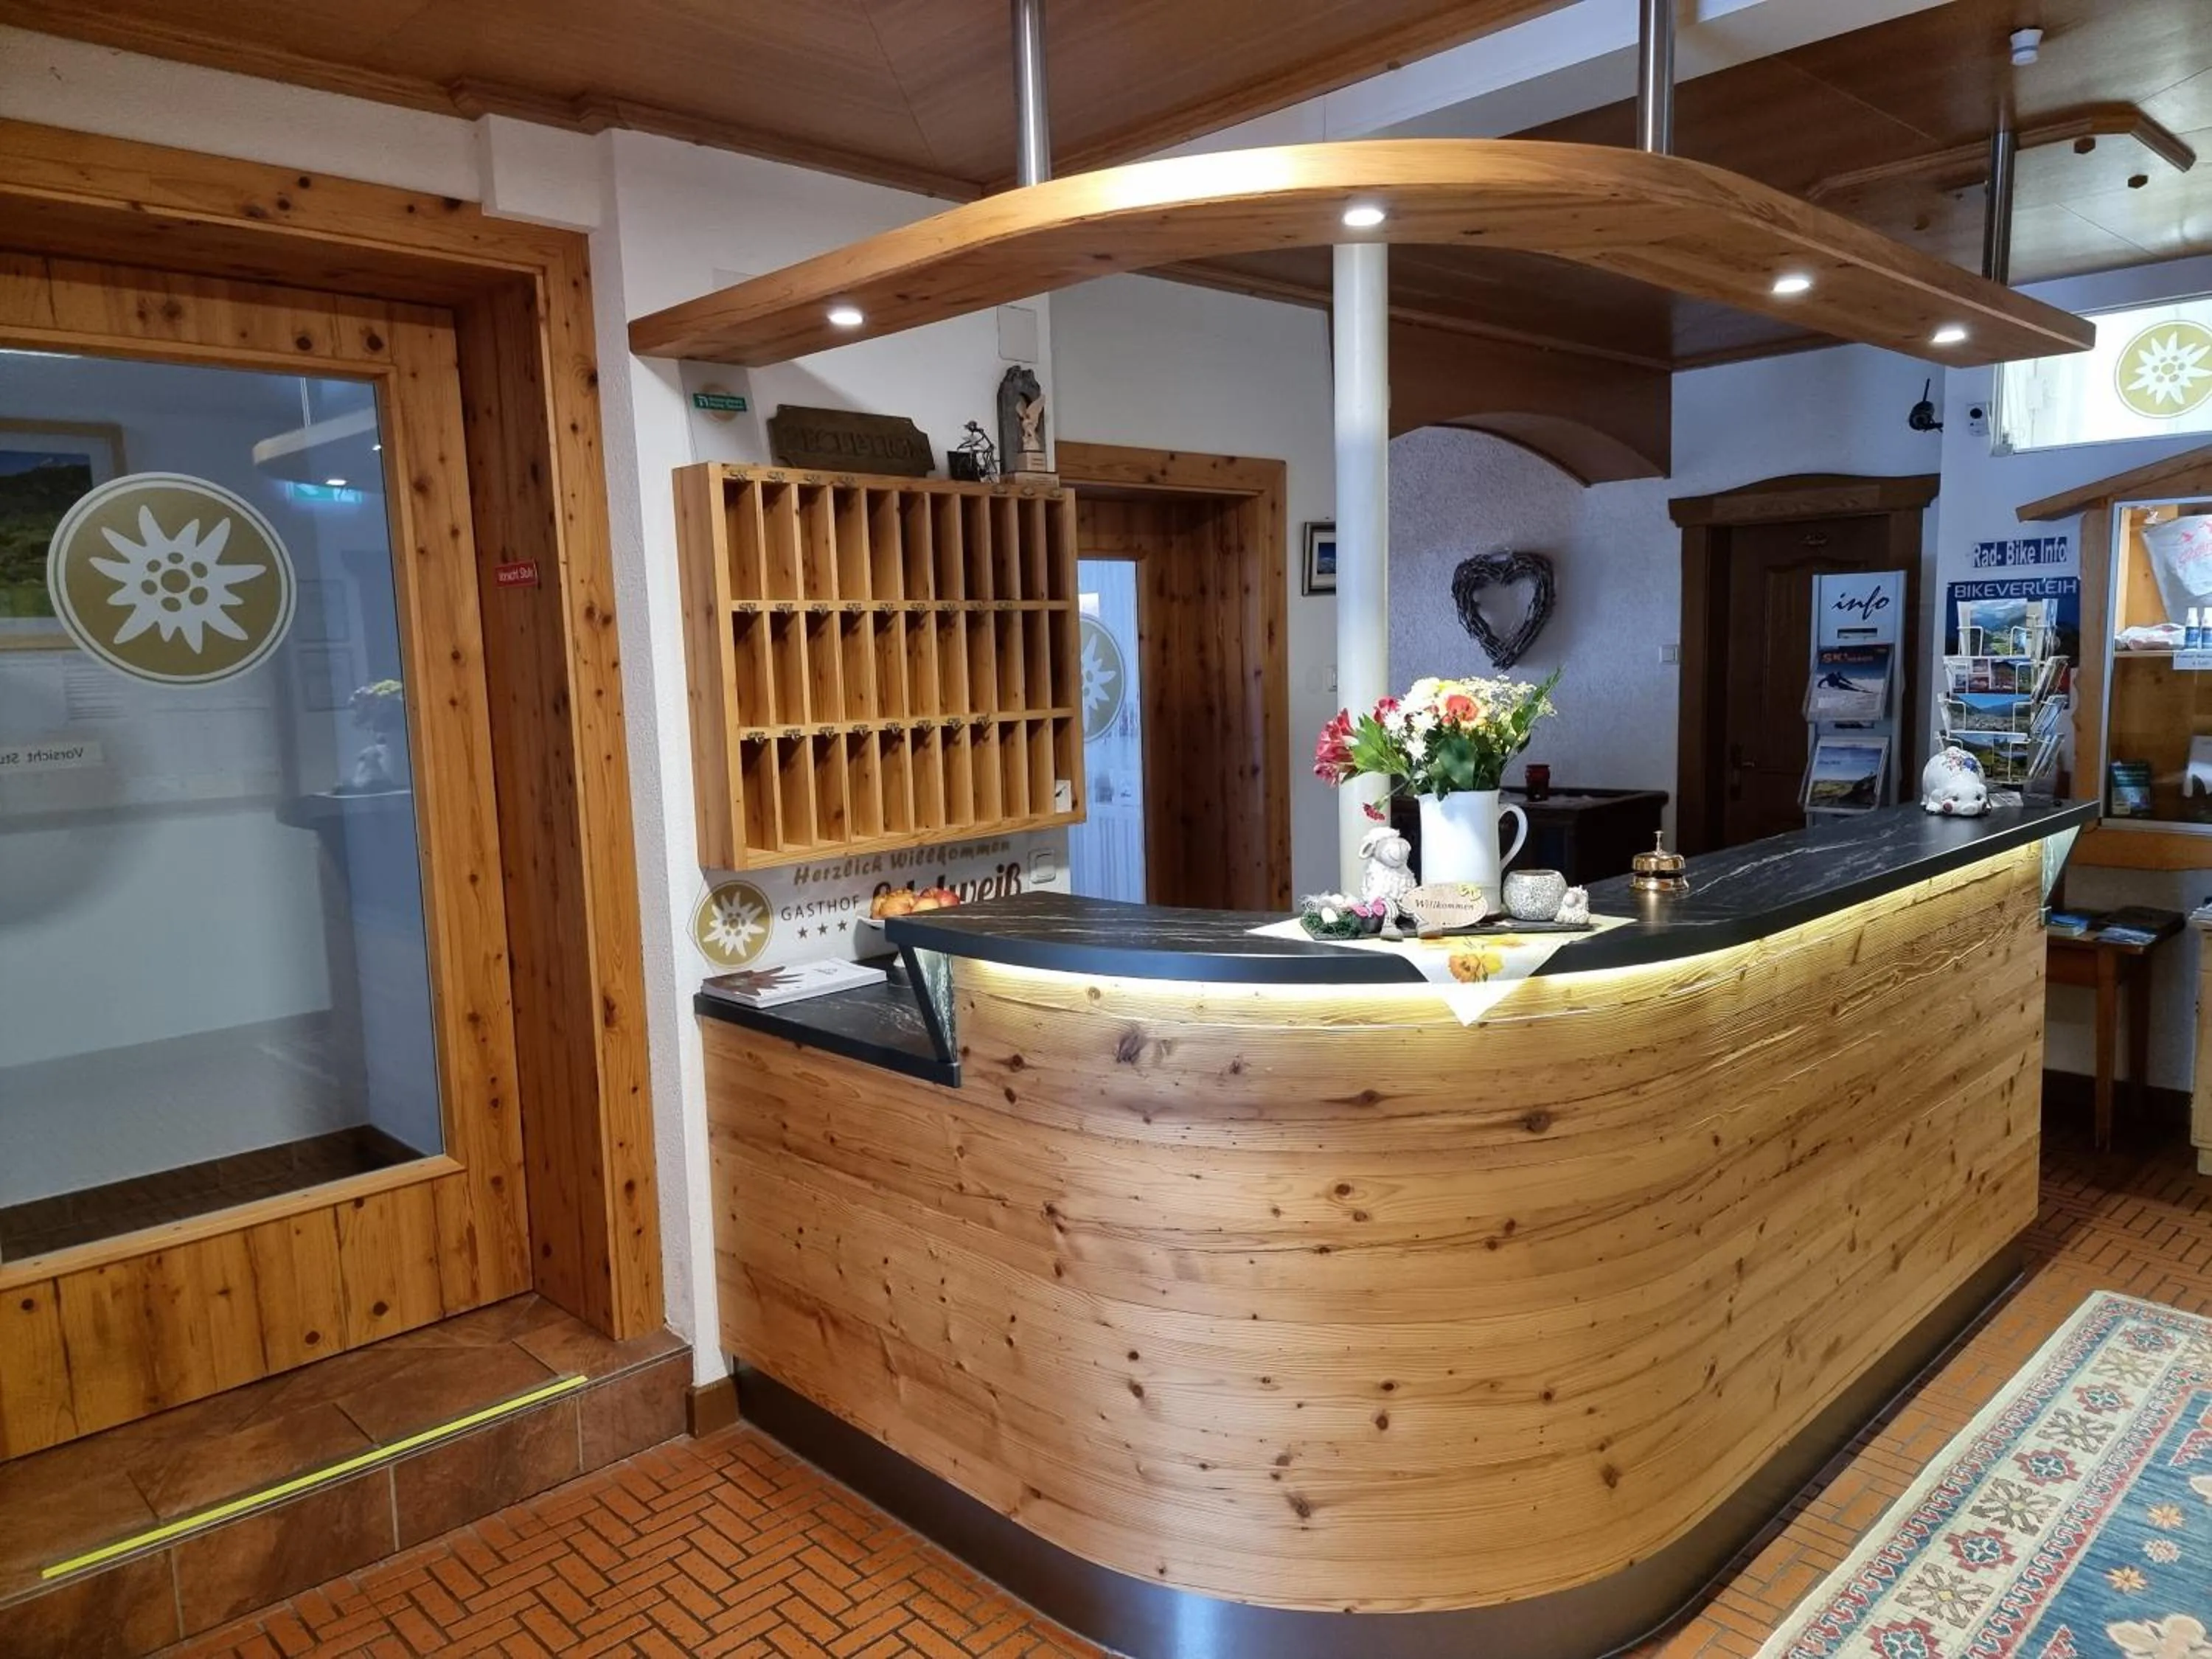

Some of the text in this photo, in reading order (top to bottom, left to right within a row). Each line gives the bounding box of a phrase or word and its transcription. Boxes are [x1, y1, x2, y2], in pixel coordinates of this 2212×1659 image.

[2006, 539, 2036, 566] Bike
[2040, 537, 2067, 563] Info
[1831, 585, 1890, 620] info
[1955, 580, 2077, 598] BIKEVERLEIH
[793, 841, 1010, 886] Herzlich Willkommen
[781, 862, 1022, 921] GASTHOF weiß
[1415, 899, 1475, 911] Willkommen
